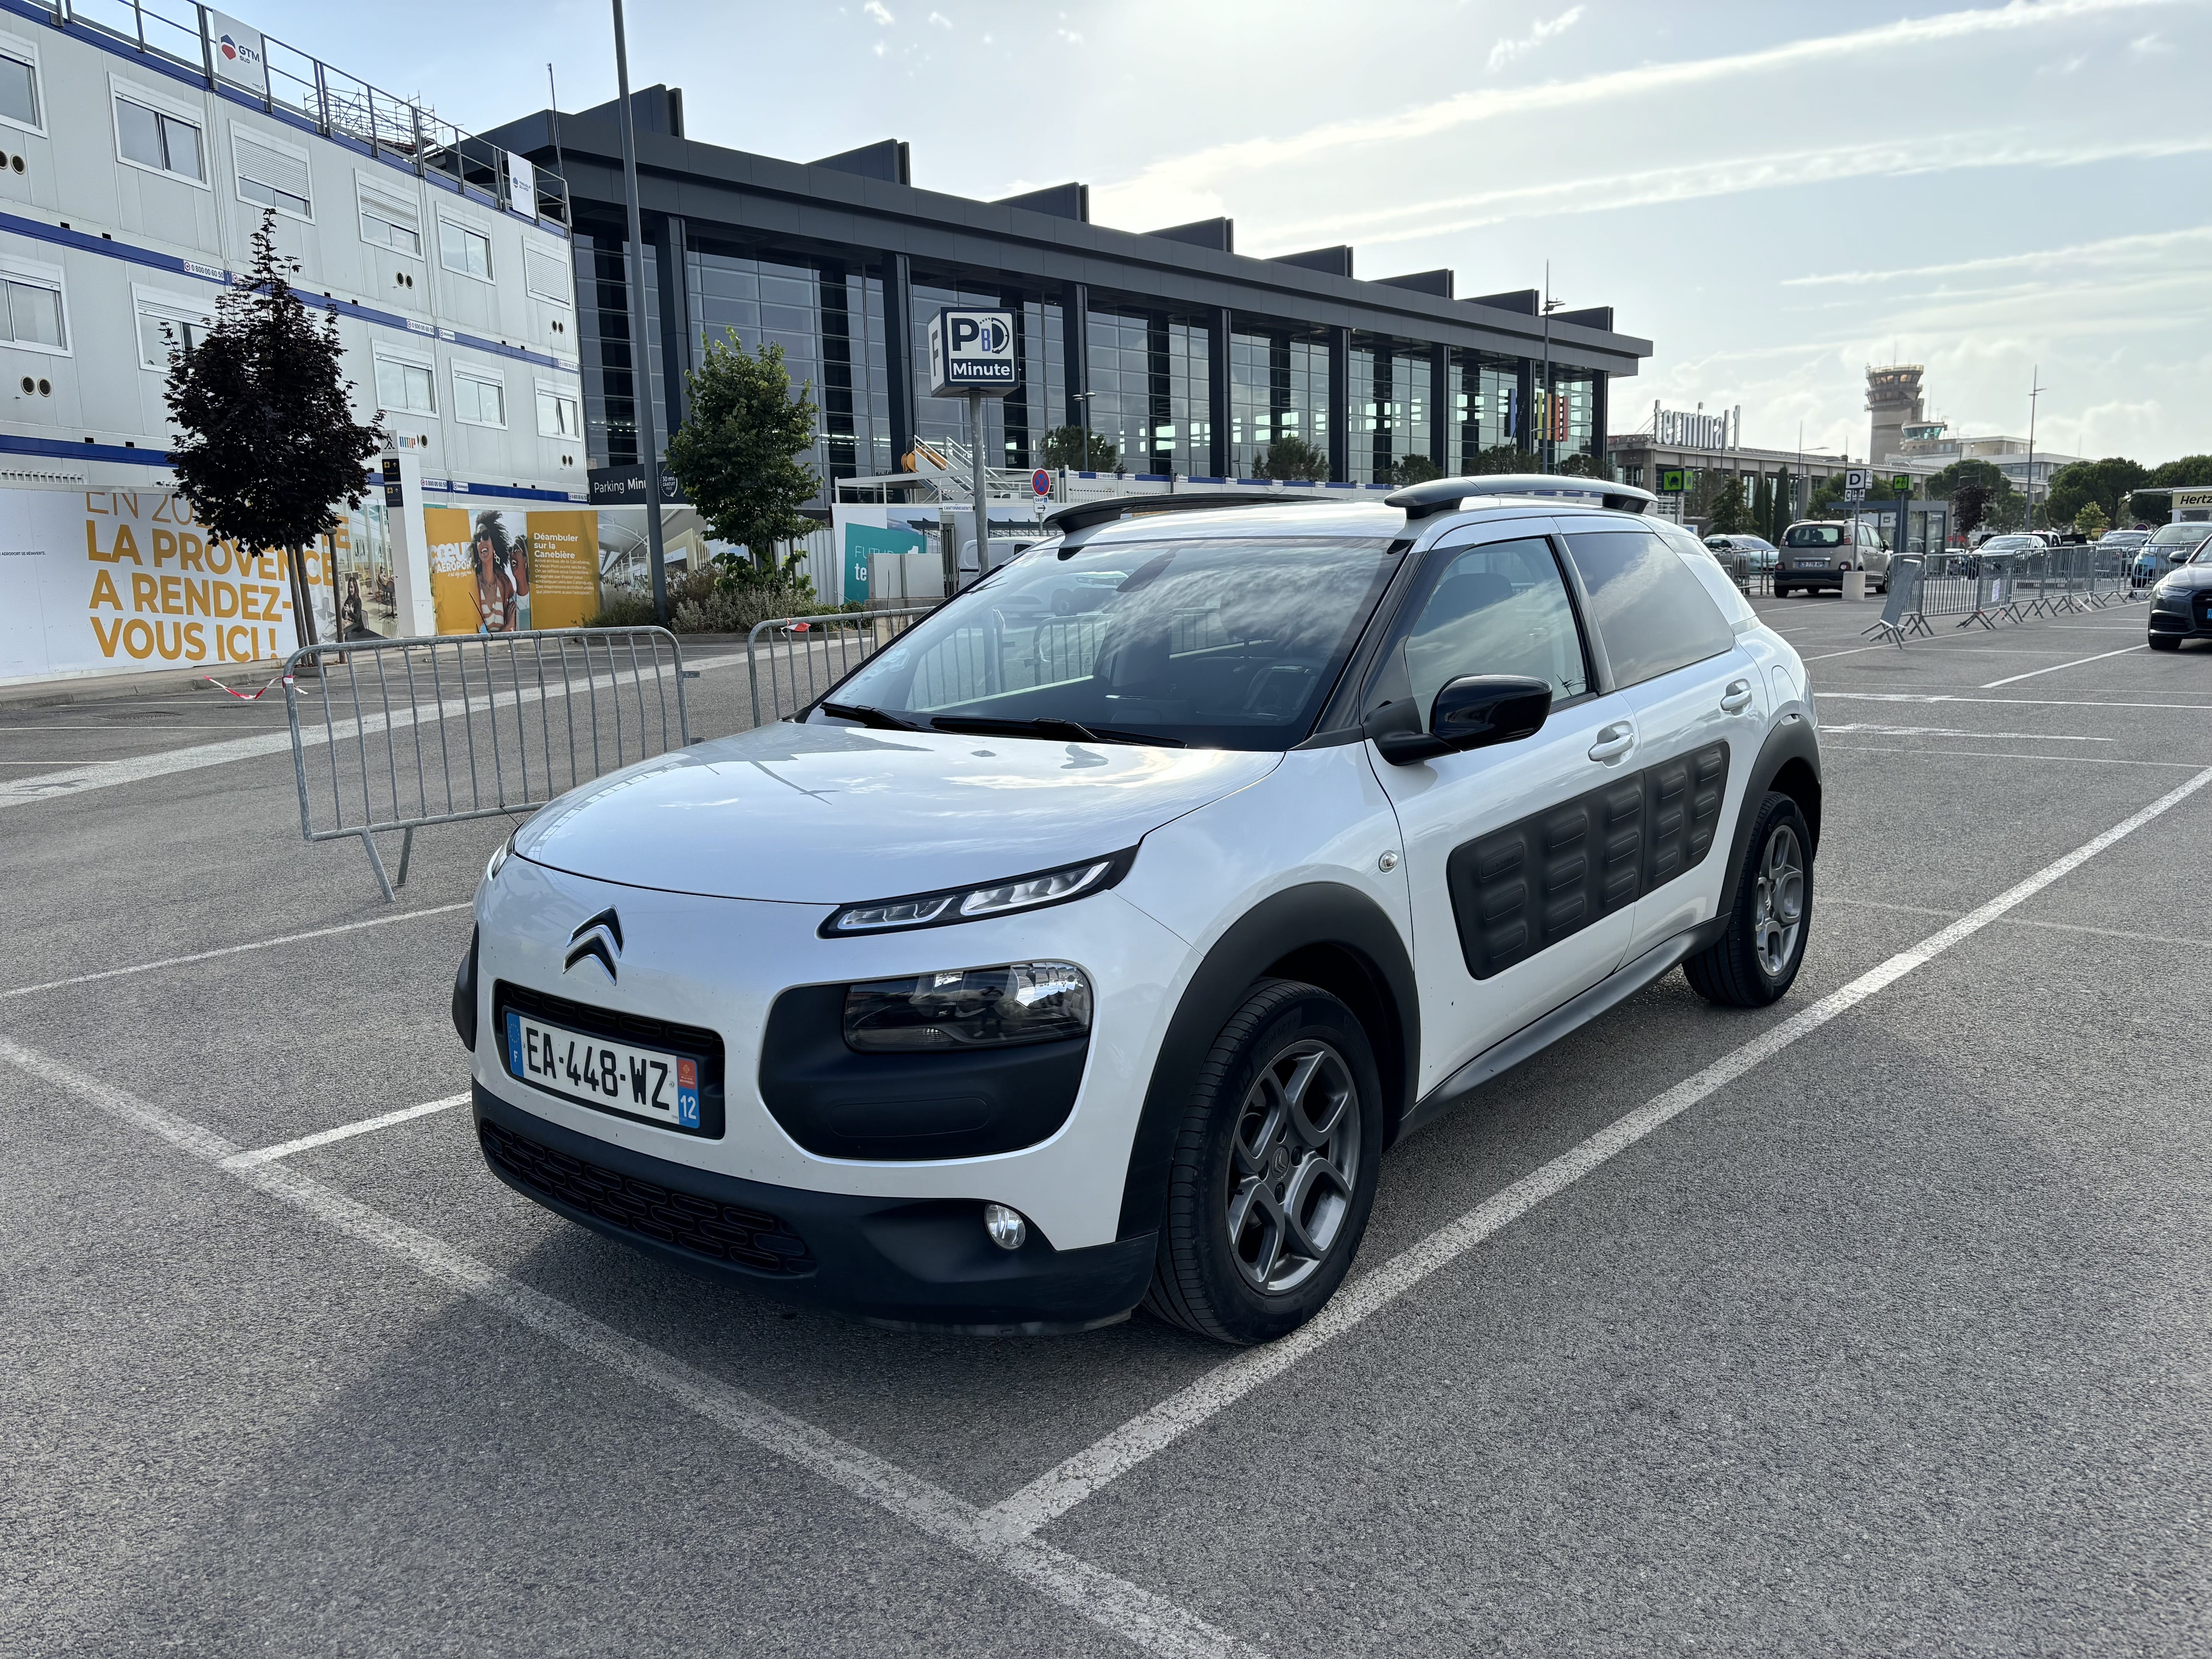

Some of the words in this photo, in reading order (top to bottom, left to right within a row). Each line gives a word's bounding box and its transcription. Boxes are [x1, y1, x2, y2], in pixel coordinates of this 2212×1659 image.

[239, 45, 260, 62] GTM
[240, 56, 250, 64] SUD
[951, 318, 979, 351] P
[953, 362, 1010, 376] Minute
[1654, 400, 1729, 450] terminal
[1733, 405, 1740, 451] 1
[1850, 474, 1861, 485] D
[594, 481, 624, 494] Parking
[2180, 495, 2212, 504] Hertz
[86, 519, 143, 565] LA
[534, 532, 579, 542] Déambuler
[534, 550, 575, 558] Canebière
[89, 569, 124, 611] A
[131, 572, 292, 622] RENDEZ-
[90, 617, 206, 661] VOUS
[216, 624, 261, 663] ICI
[514, 1051, 518, 1062] F
[680, 1095, 697, 1120] 12
